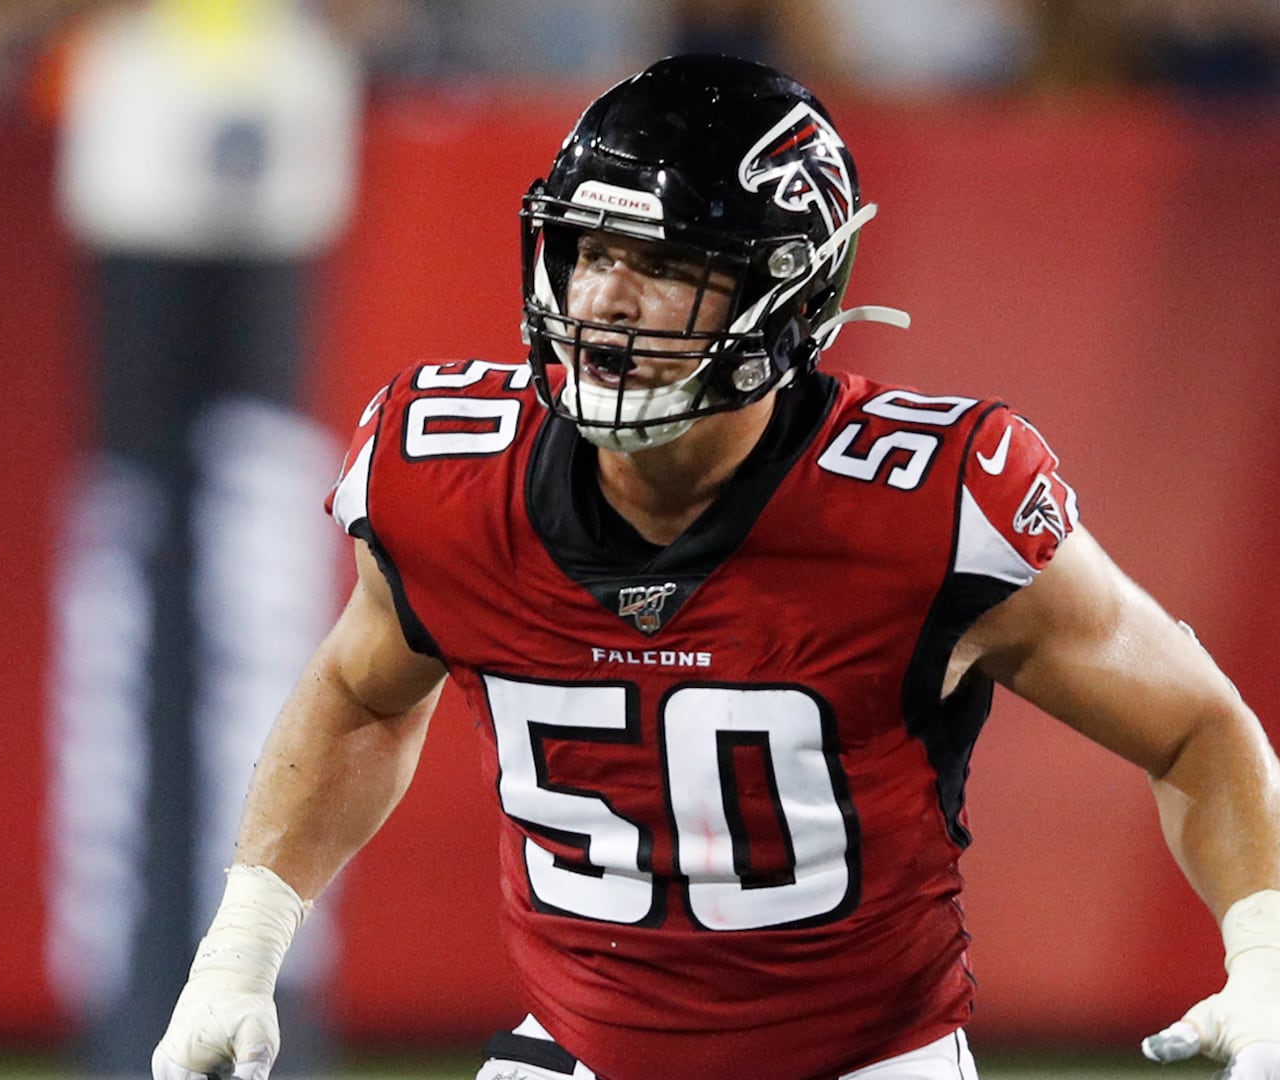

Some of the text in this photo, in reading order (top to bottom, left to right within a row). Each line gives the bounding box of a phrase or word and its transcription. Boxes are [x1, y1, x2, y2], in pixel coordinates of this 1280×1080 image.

[581, 189, 651, 212] FALCONS
[403, 359, 533, 458] 50
[816, 389, 980, 491] 50
[591, 647, 712, 667] FALCONS
[483, 674, 850, 931] 50
